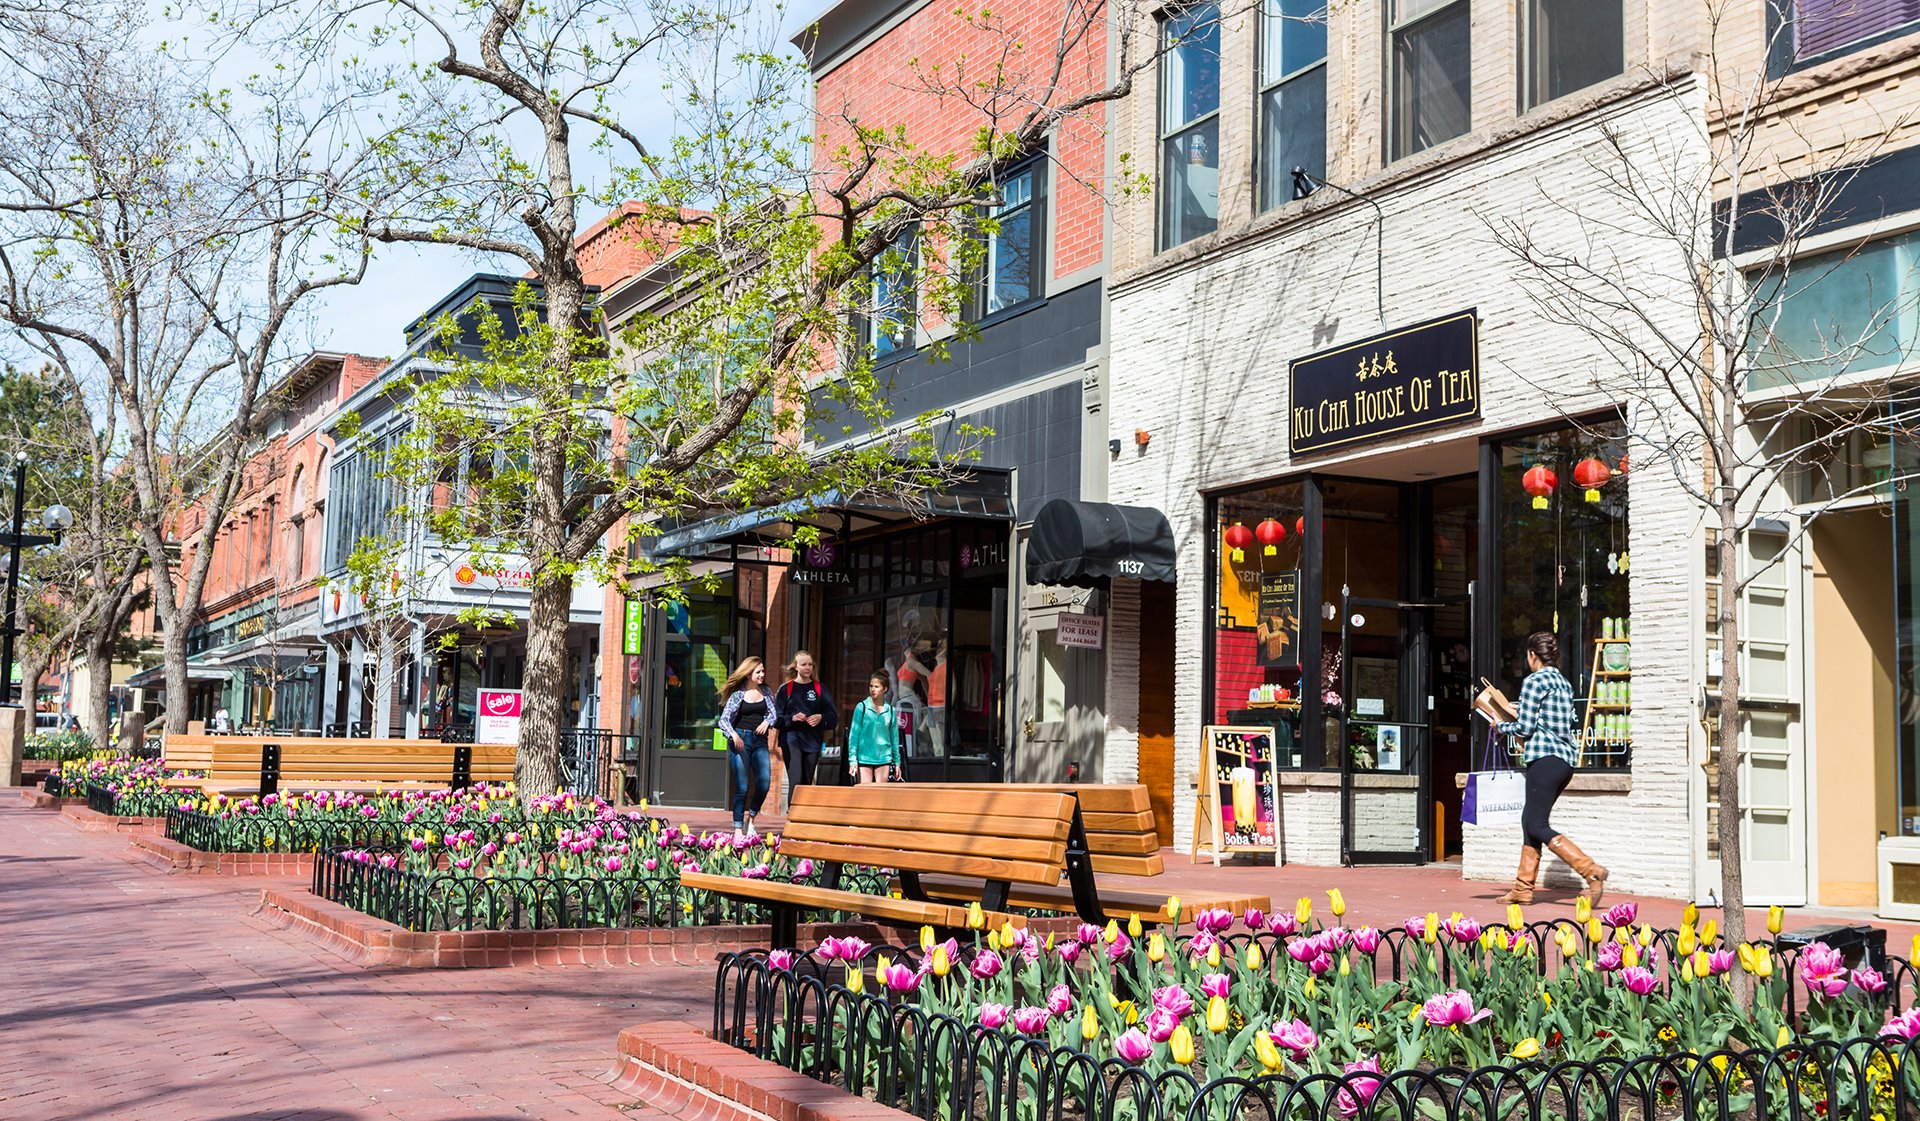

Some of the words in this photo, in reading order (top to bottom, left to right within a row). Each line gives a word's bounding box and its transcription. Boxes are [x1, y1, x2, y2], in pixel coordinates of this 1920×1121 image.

[1438, 369, 1473, 406] TEA
[972, 543, 1006, 567] ATHL
[1118, 560, 1144, 574] 1137
[792, 570, 850, 583] ATHLETA
[1061, 616, 1080, 624] OFFICE
[1082, 619, 1100, 627] SUITES
[1061, 626, 1076, 634] FOR
[1078, 628, 1098, 637] LEASE
[489, 694, 513, 709] sale
[1481, 801, 1524, 812] WEEKENDS
[1224, 832, 1250, 845] Boba
[1251, 832, 1274, 845] Tea
